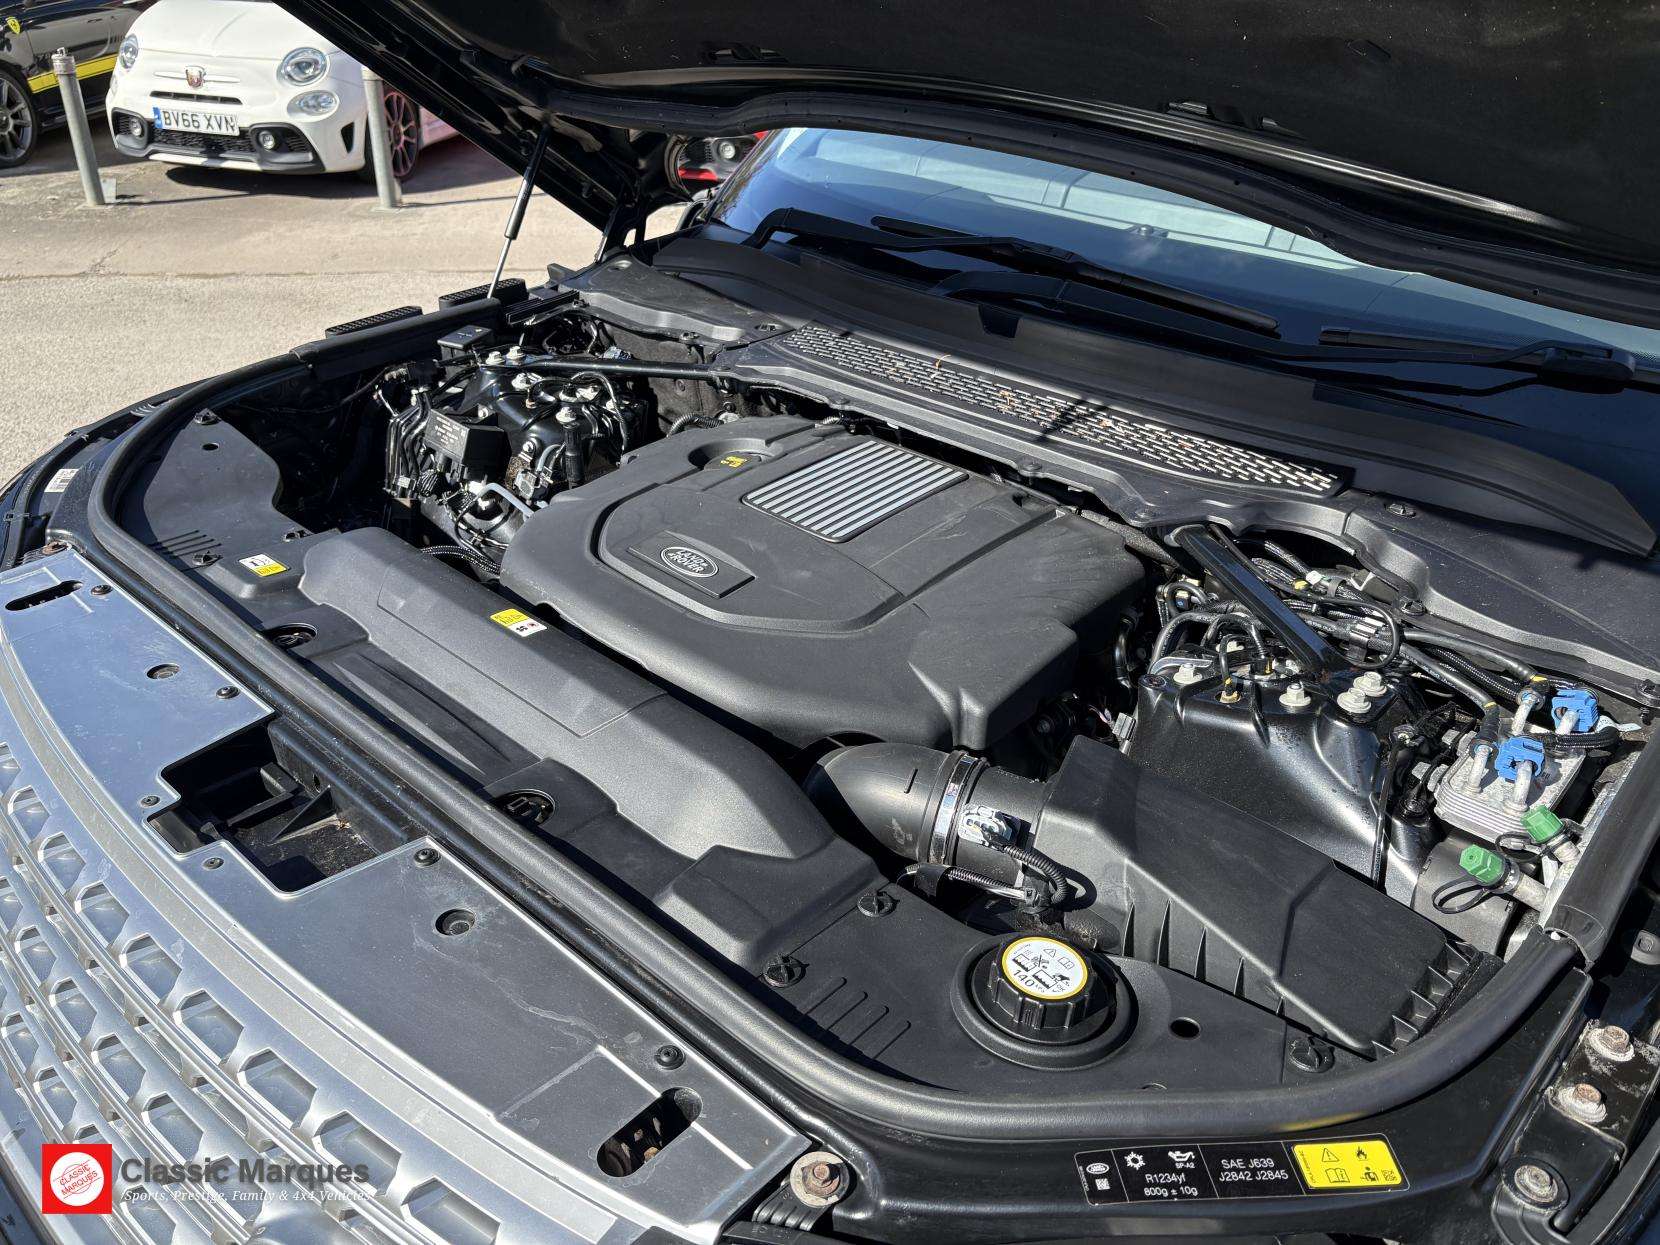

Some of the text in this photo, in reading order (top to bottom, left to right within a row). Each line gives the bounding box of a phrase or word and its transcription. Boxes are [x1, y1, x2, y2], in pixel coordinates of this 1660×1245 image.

[162, 111, 200, 128] BV66
[669, 554, 704, 573] ROVER
[676, 550, 704, 566] LAND
[1013, 969, 1035, 987] 140
[1221, 1157, 1275, 1169] SAE J639
[1219, 1169, 1289, 1182] J2842 J2845
[1143, 1187, 1168, 1197] 800g
[1180, 1186, 1199, 1196] 10g
